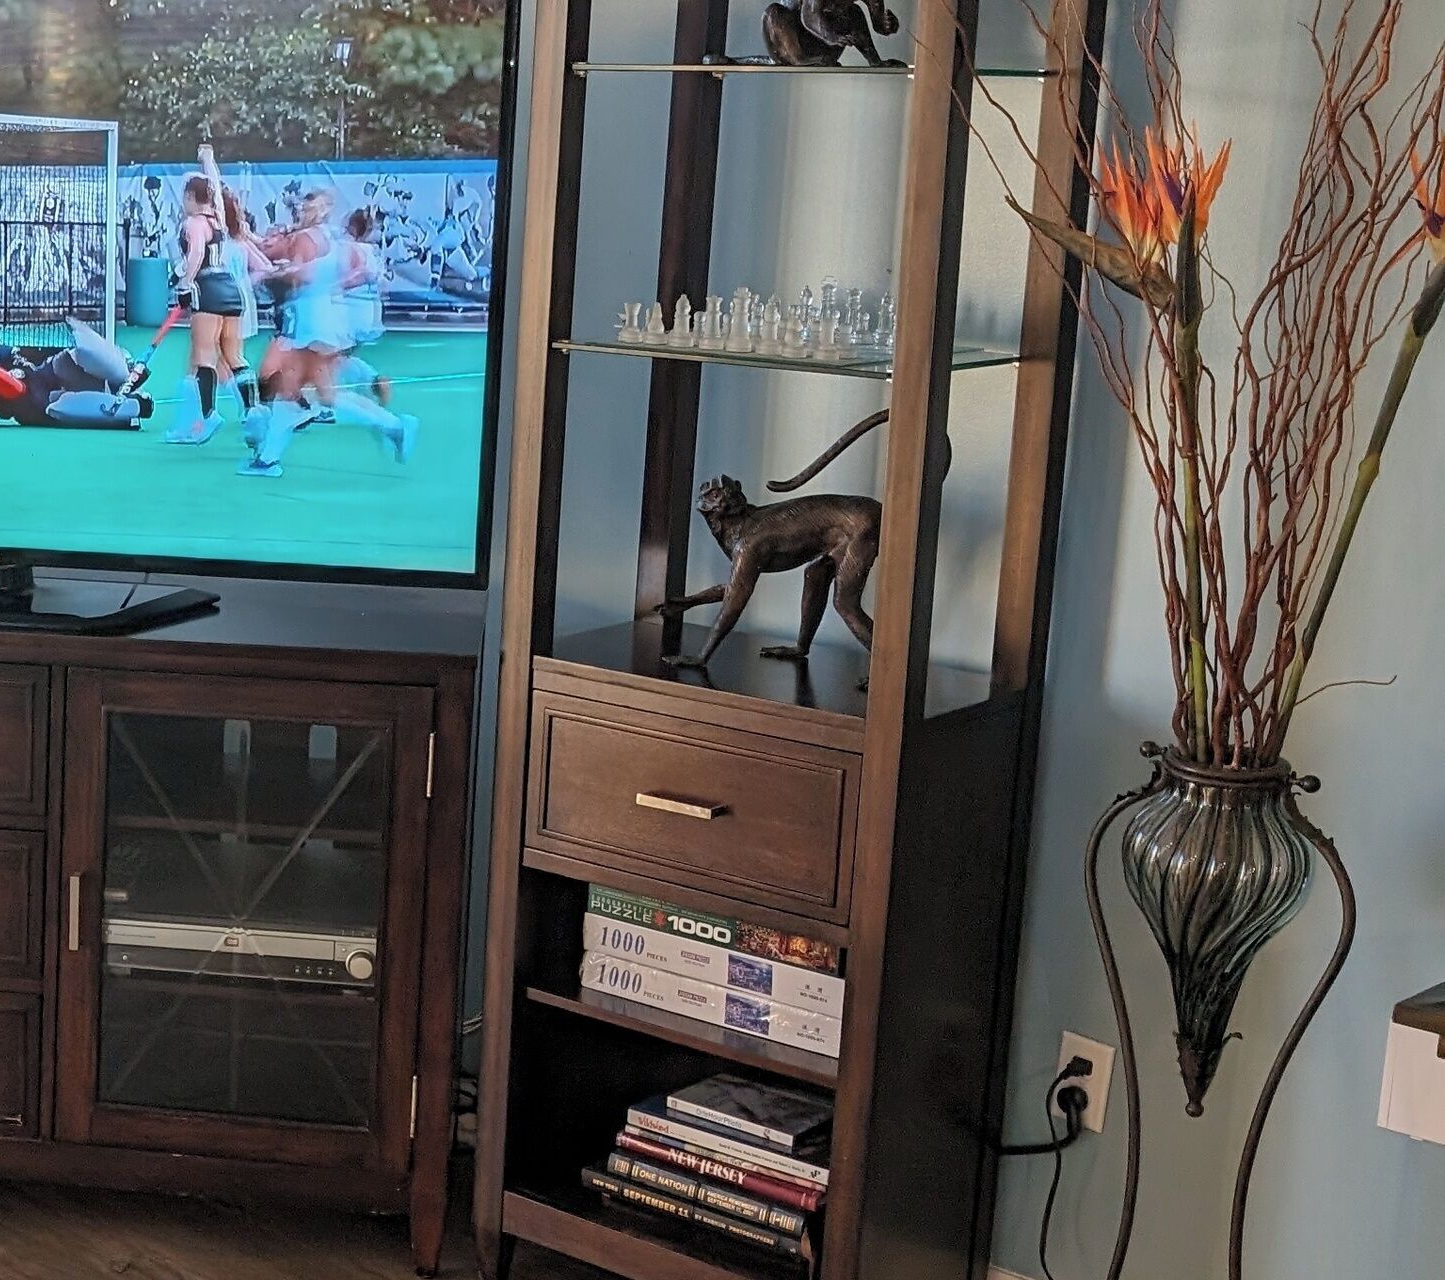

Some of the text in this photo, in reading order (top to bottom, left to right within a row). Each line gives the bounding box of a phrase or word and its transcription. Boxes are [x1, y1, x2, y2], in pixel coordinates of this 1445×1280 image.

[591, 900, 652, 924] PUZZLE
[667, 915, 731, 944] 1000
[600, 925, 668, 963] 1000 PIECES
[597, 963, 664, 1001] 1000 PIECES
[639, 1169, 689, 1191] ONE NATION
[667, 1148, 699, 1168] NEW
[698, 1159, 748, 1185] JERSEY
[592, 1178, 619, 1192] NEW YORK
[623, 1188, 689, 1218] SEPTEMBER 11
[694, 1213, 702, 1221] BY
[707, 1196, 736, 1210] SEPTEMBER
